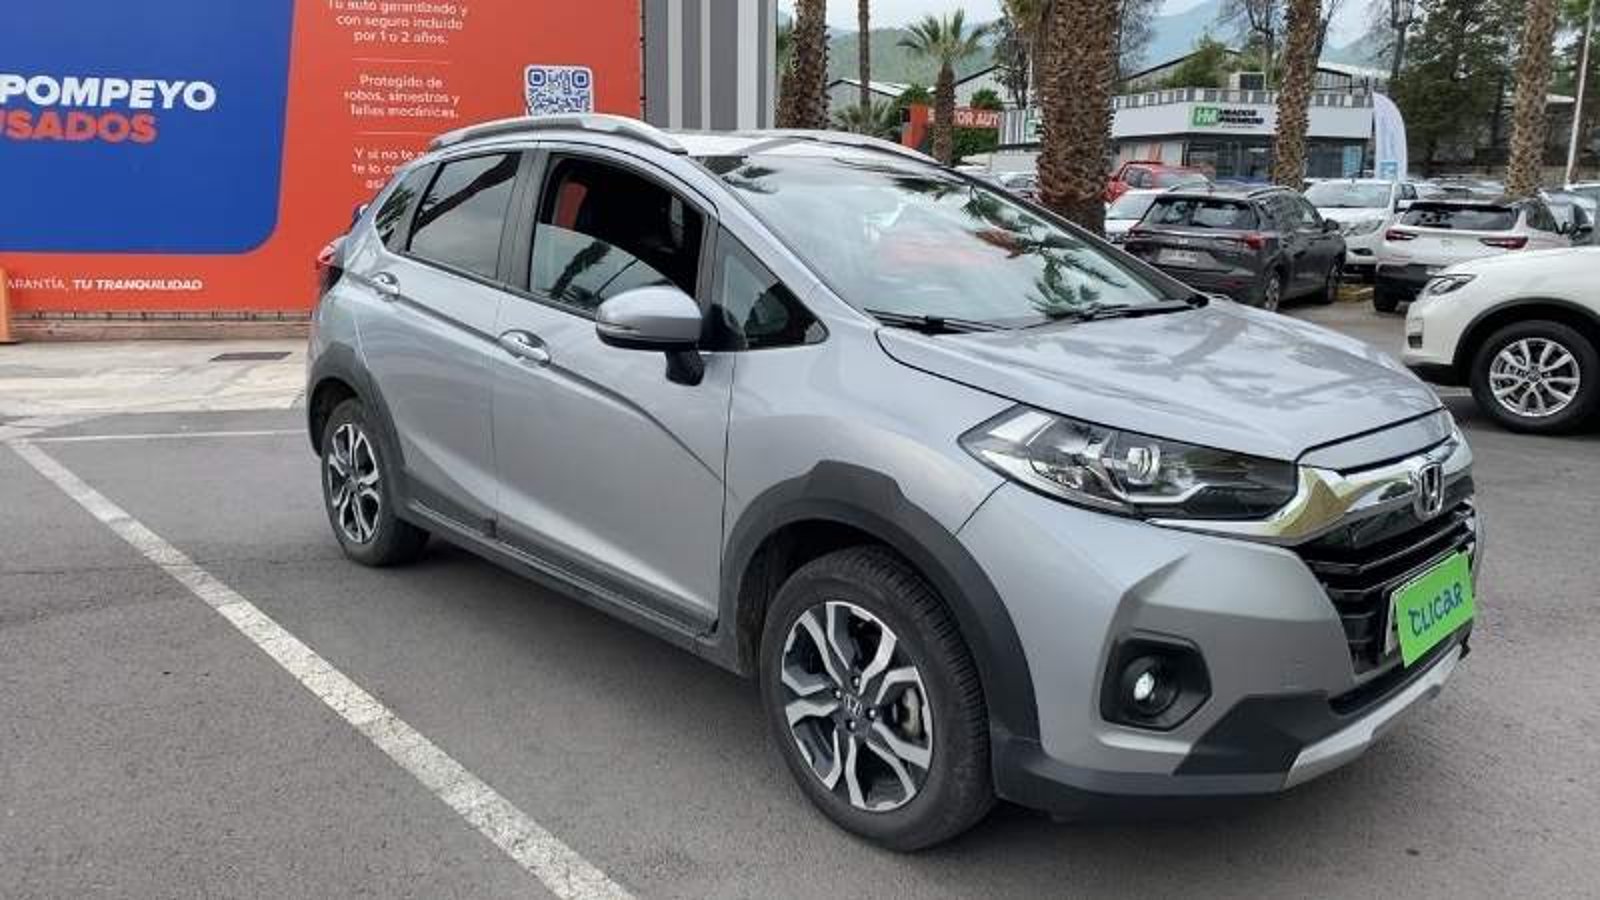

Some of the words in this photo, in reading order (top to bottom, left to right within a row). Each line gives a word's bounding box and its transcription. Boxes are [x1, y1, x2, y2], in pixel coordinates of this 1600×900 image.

[380, 1, 457, 14] garantizado
[336, 15, 361, 25] con
[365, 17, 409, 29] seguro
[413, 17, 463, 30] incluido
[353, 30, 376, 43] por
[379, 30, 386, 41] 1
[389, 34, 398, 43] o
[401, 31, 410, 43] 2
[413, 31, 448, 44] años.
[360, 74, 422, 88] Protegido
[427, 77, 443, 88] de
[0, 74, 216, 111] POMPEYO
[388, 91, 448, 103] siniestros
[451, 95, 460, 107] y
[387, 105, 459, 119] mecánicas.
[354, 147, 364, 159] Y
[381, 151, 399, 160] no
[401, 150, 414, 161] te
[351, 163, 365, 174] te
[368, 163, 381, 174] lo
[72, 279, 93, 290] TU
[96, 278, 203, 291] TRANQUILIDAD
